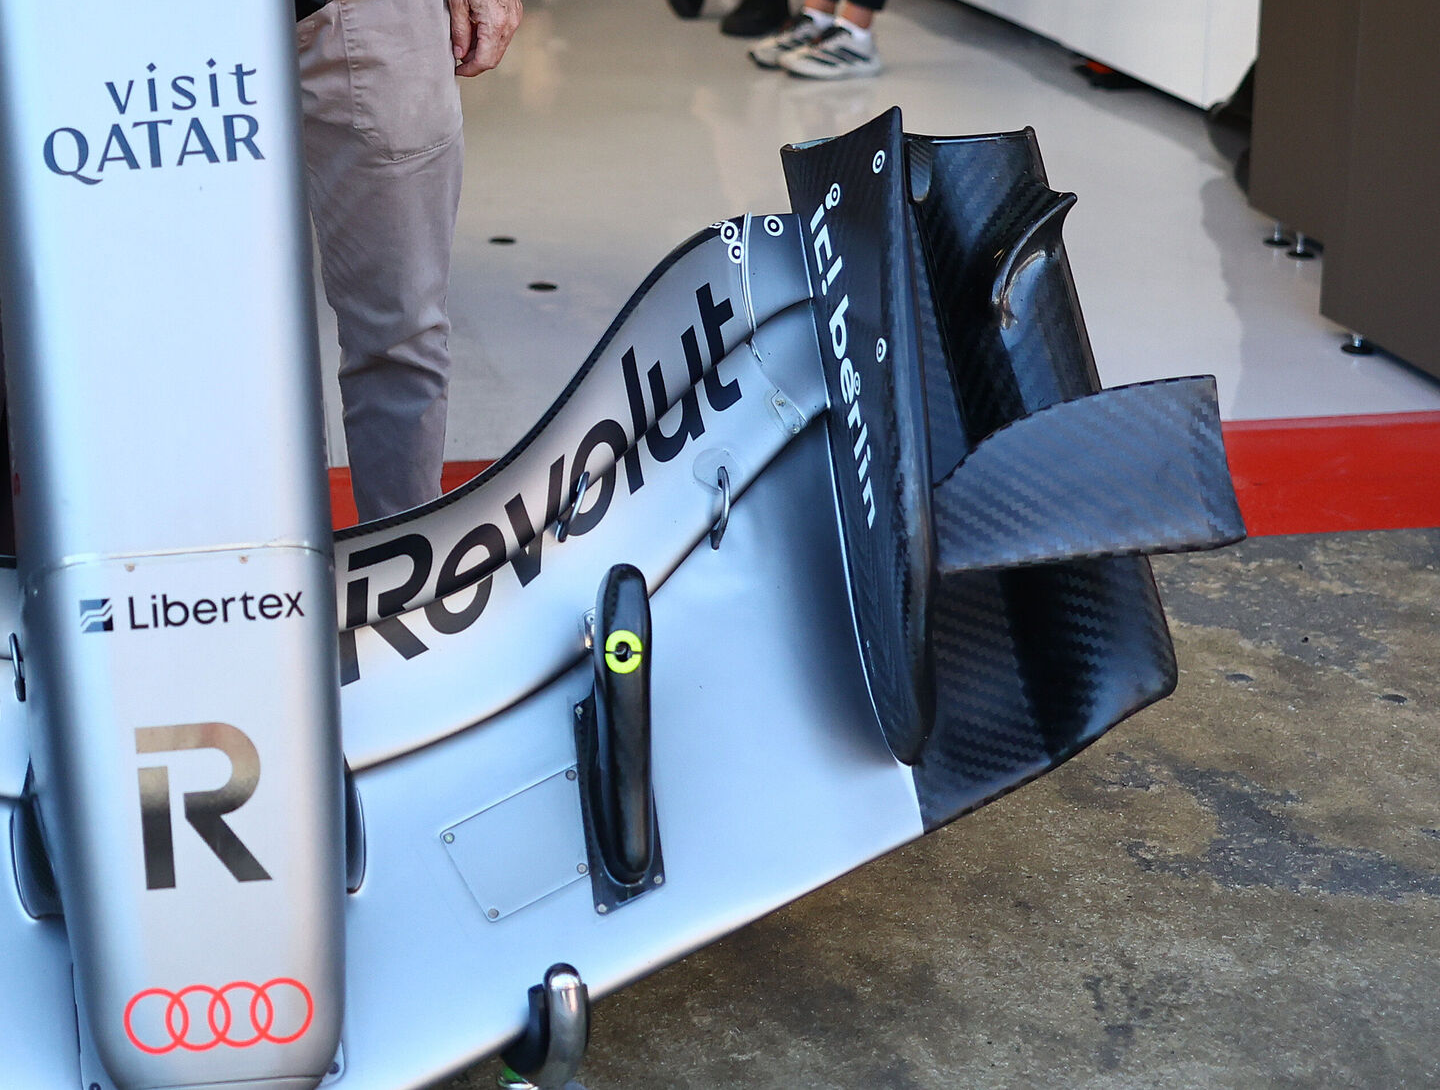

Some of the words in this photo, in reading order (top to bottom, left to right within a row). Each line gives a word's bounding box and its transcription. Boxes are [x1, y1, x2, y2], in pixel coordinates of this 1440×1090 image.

[105, 57, 258, 116] visit
[43, 113, 266, 186] QATAR
[829, 294, 876, 530] berlin
[340, 281, 743, 687] Revolut
[128, 588, 306, 631] Libertex
